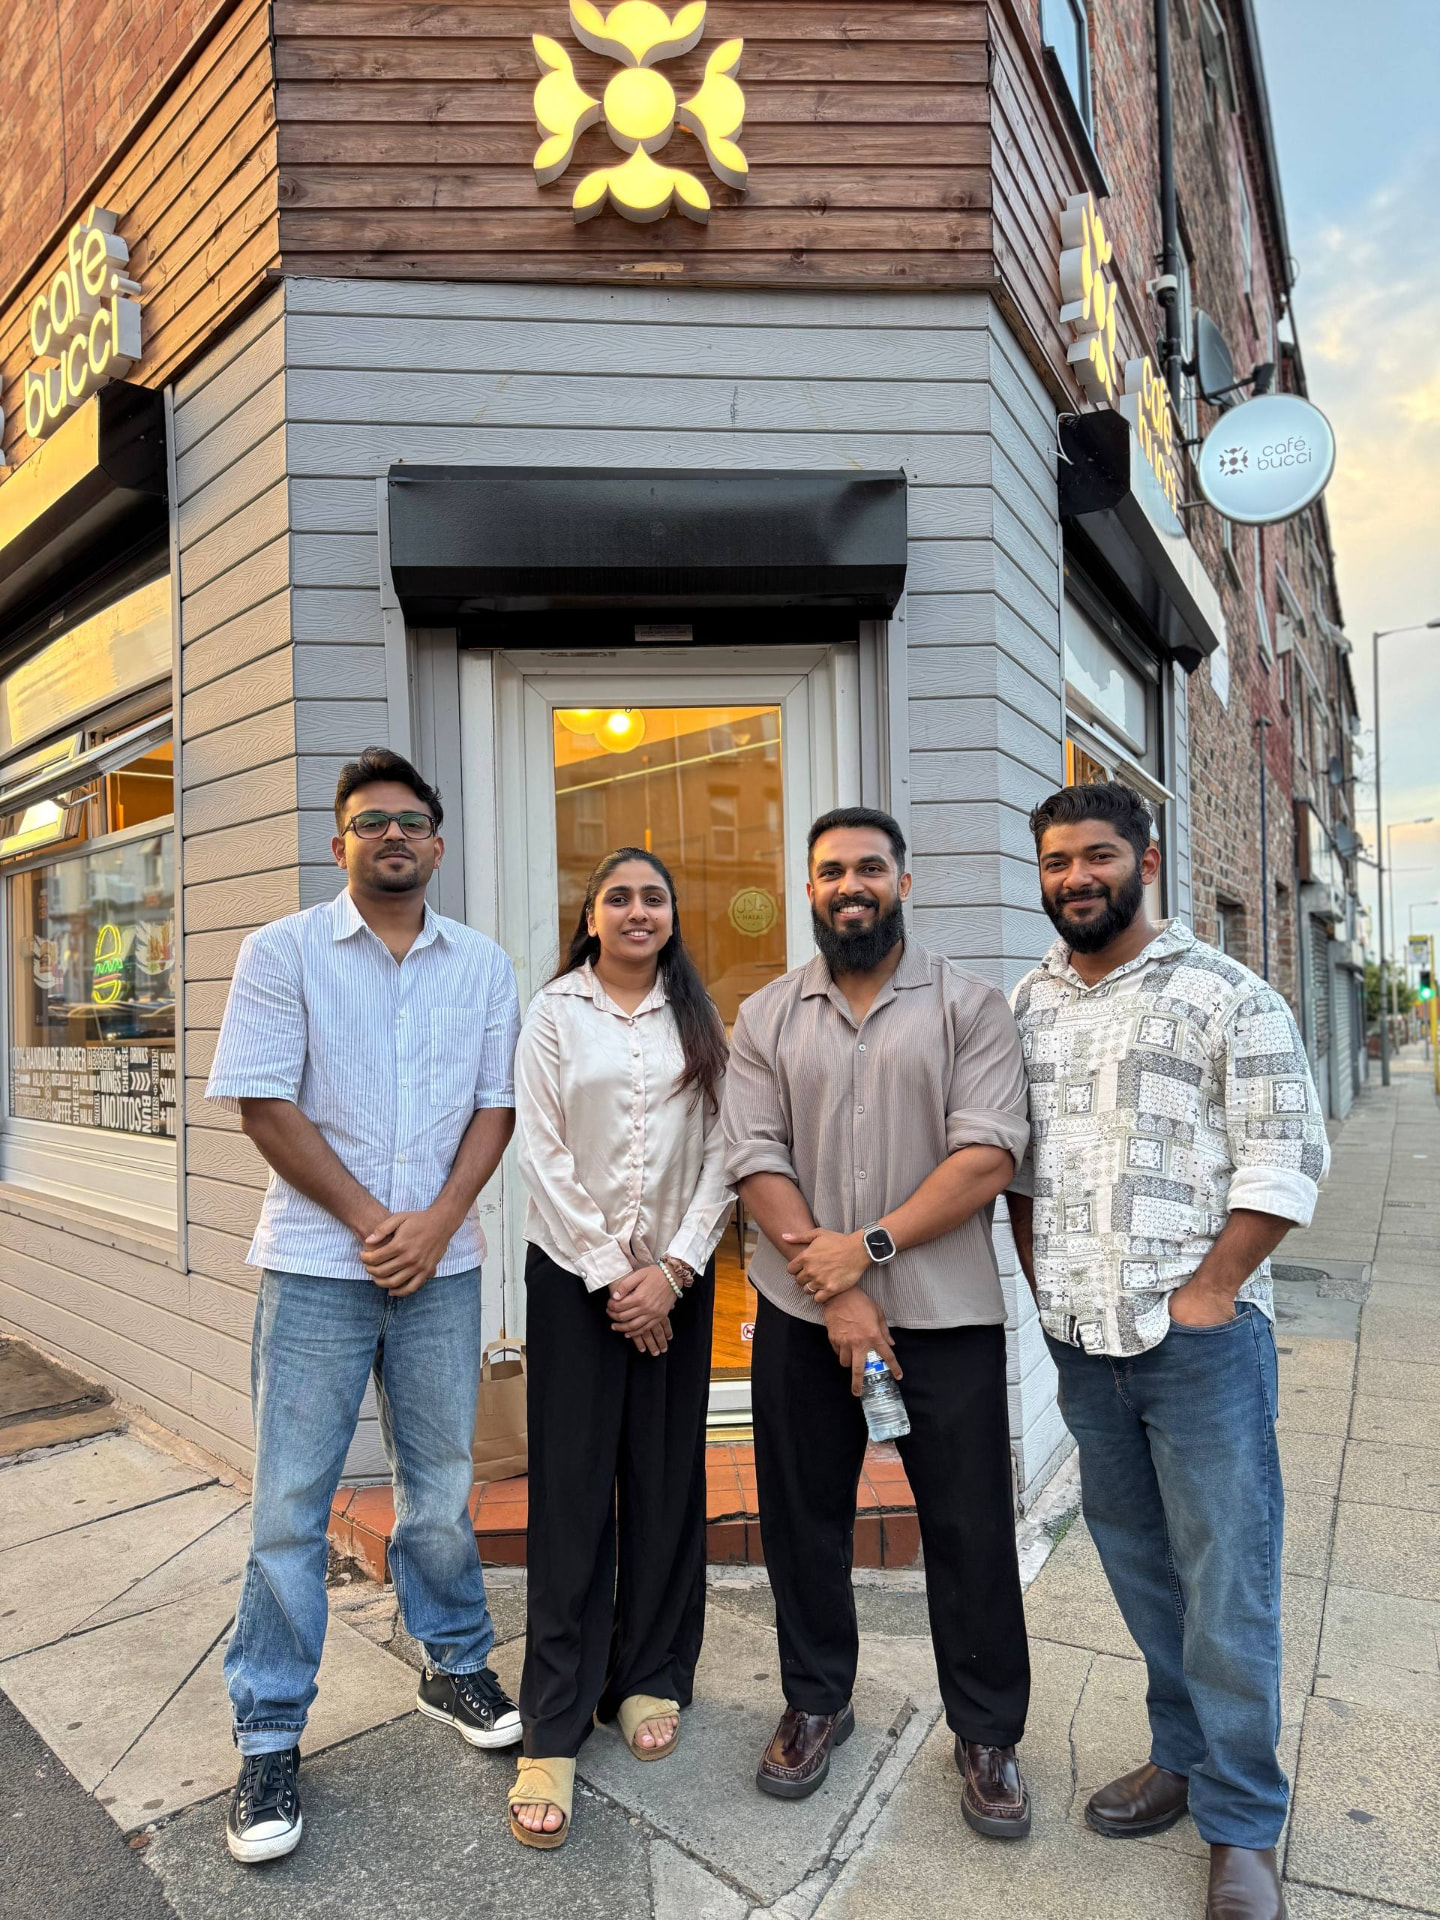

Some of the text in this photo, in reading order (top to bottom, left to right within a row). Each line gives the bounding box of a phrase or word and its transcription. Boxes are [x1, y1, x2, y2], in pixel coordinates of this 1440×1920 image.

[30, 204, 108, 357] café
[24, 272, 119, 440] bucci
[1262, 435, 1306, 457] café
[1257, 447, 1312, 471] bucci
[26, 1047, 60, 1070] HANDMADE
[60, 1047, 87, 1072] BURGER
[87, 1046, 116, 1070] DESSERT
[129, 1047, 149, 1064] DRINKS
[121, 1046, 130, 1093] CHEESE
[100, 1071, 121, 1094] WINGS
[51, 1100, 72, 1124] COFFEE
[72, 1074, 80, 1125] CHEESE
[101, 1095, 142, 1132] MOJITOS
[141, 1095, 152, 1134] BUN
